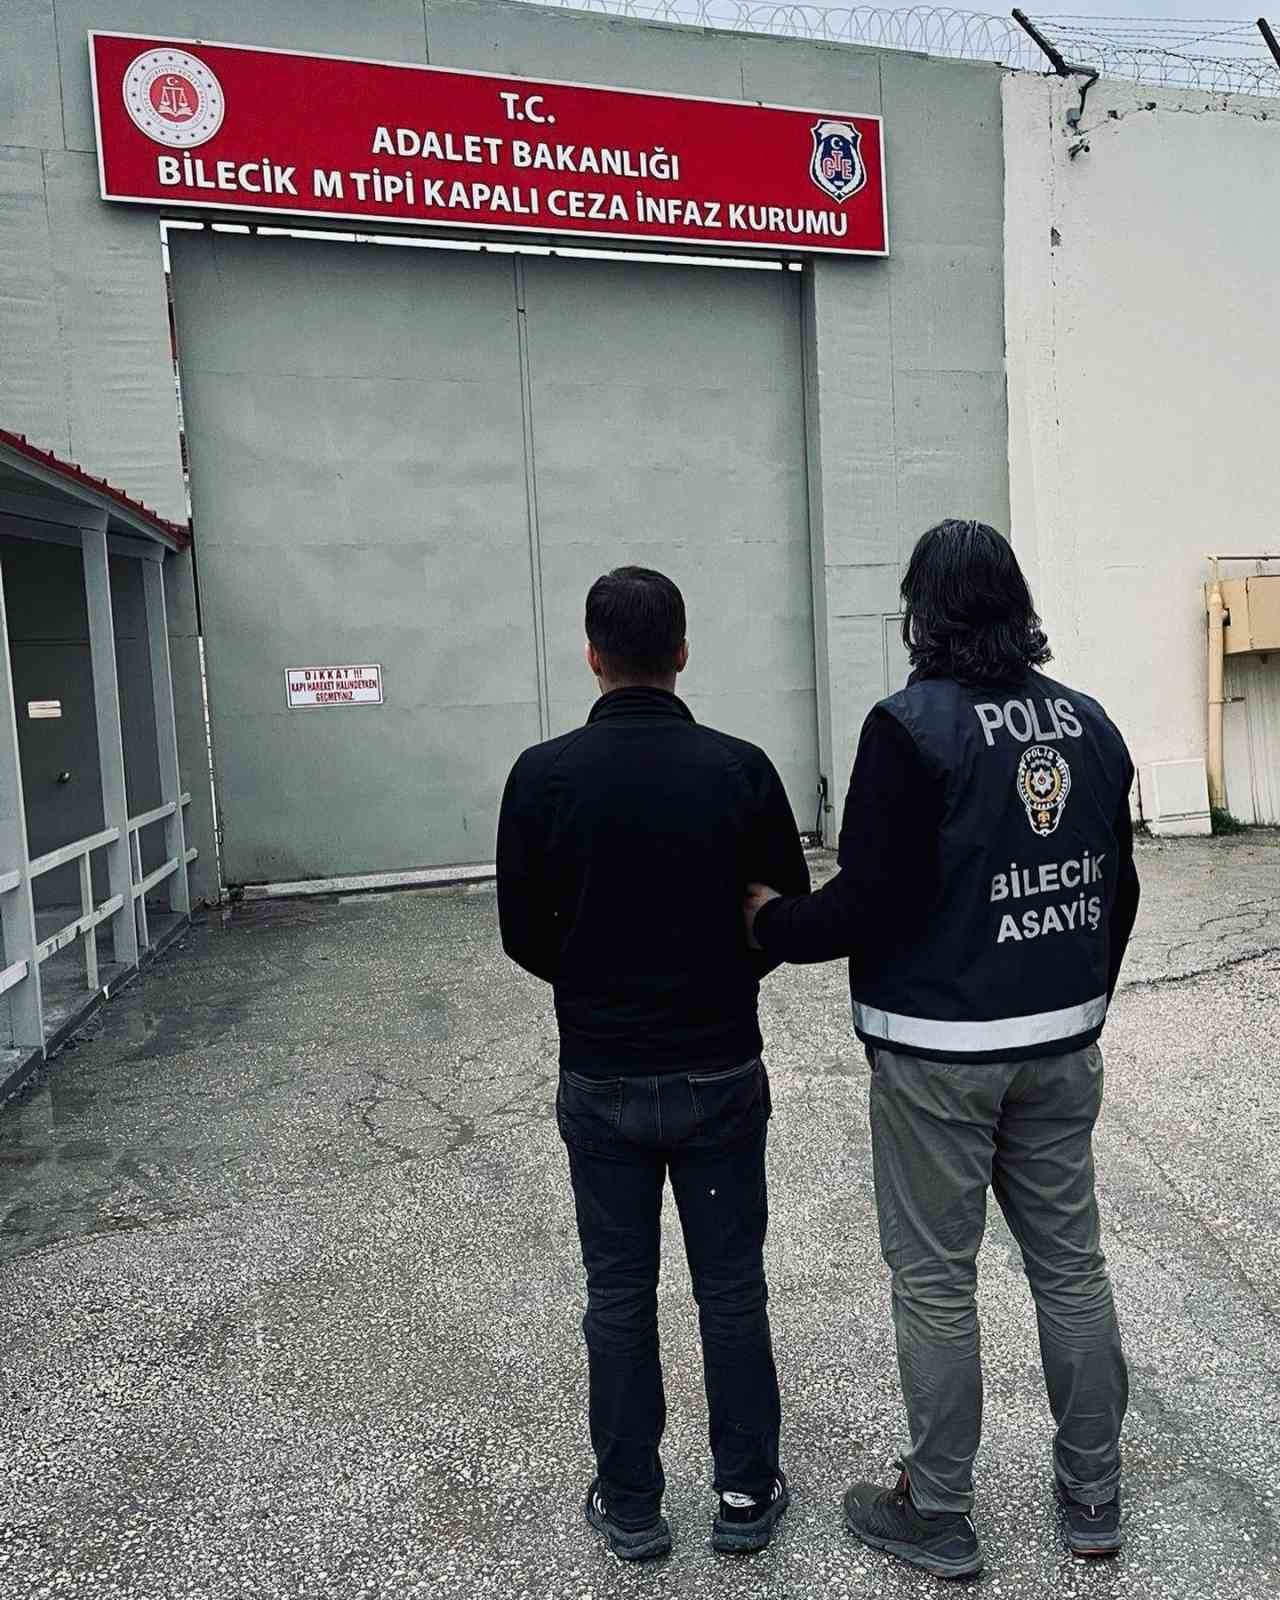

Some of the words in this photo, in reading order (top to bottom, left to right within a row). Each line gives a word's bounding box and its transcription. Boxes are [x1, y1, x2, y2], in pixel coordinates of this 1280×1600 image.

[500, 91, 557, 124] T.C.
[371, 126, 503, 165] ADALET
[512, 140, 680, 181] BAKANLIĞI
[157, 150, 298, 196] BİLECİK
[313, 168, 344, 199] M
[351, 167, 414, 203] TİPİ
[424, 177, 539, 214] KAPALI
[547, 188, 629, 221] CEZA
[636, 189, 722, 228] İNFAZ
[729, 204, 848, 237] KURUMU
[989, 850, 1106, 903] BİLECİK
[996, 892, 1102, 944] ASAYİŞ
